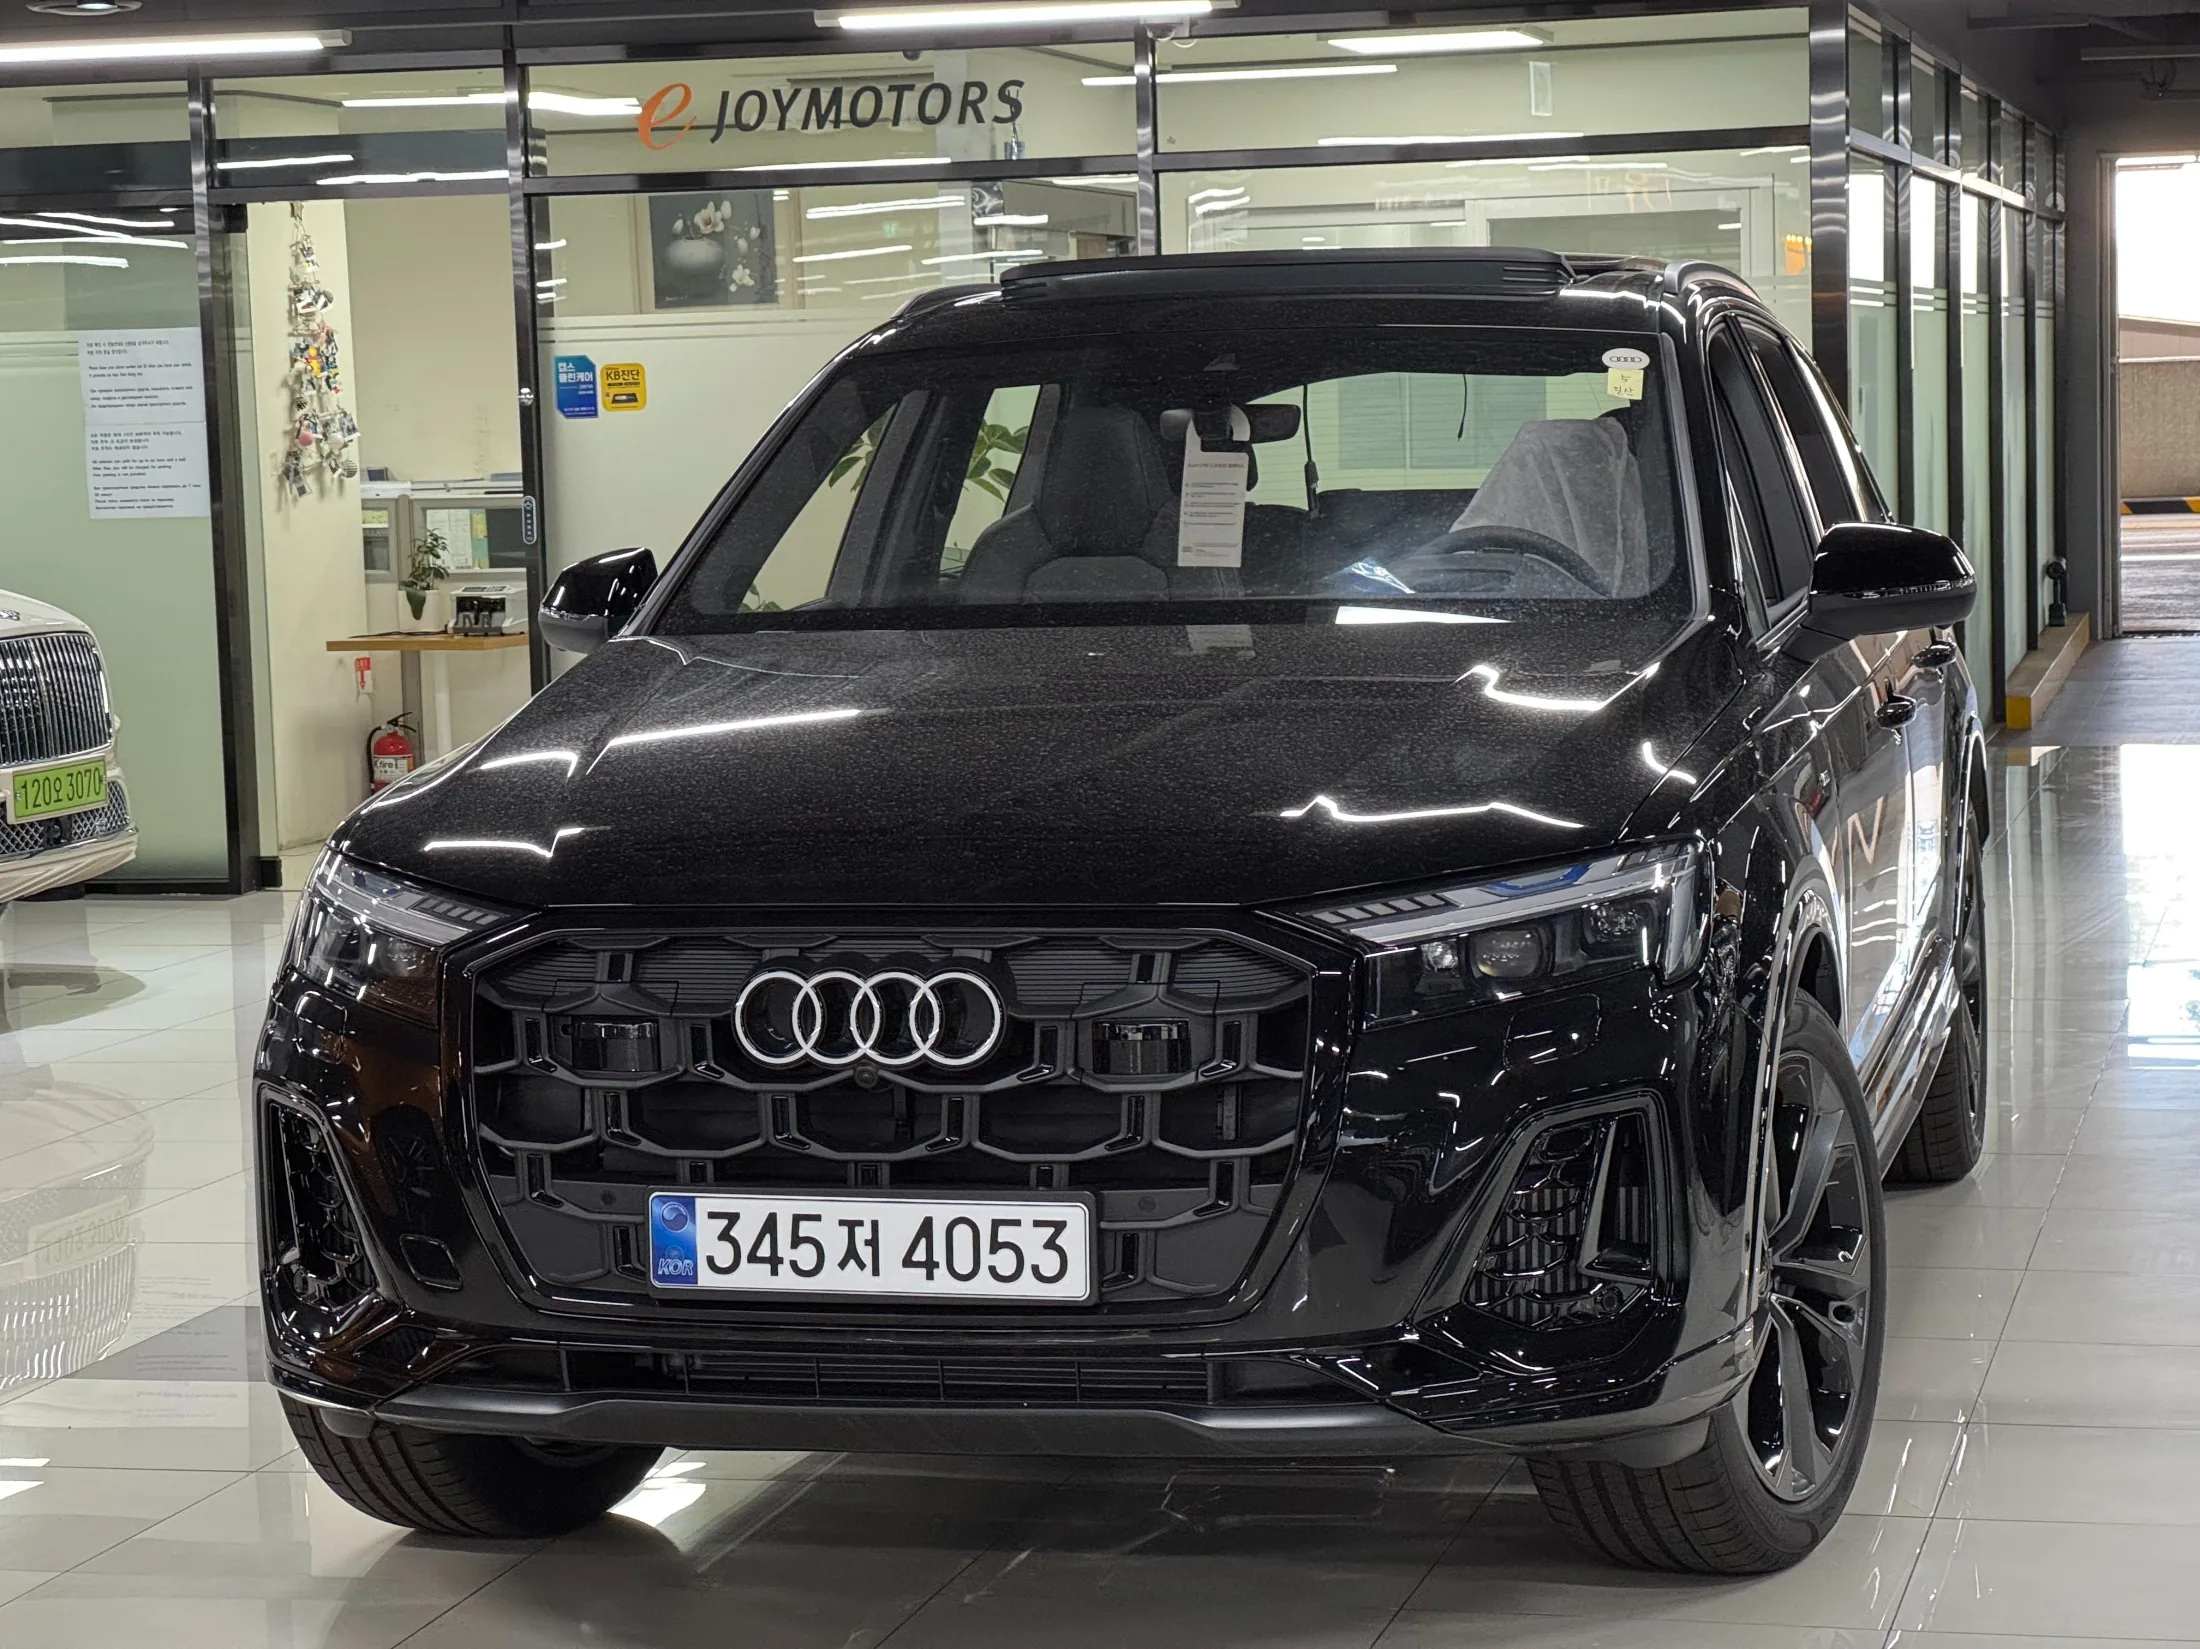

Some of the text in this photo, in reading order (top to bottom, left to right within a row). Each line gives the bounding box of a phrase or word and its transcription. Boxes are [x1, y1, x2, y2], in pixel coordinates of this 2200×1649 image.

[709, 79, 1025, 144] JOYMOTORS
[606, 369, 640, 380] KB진단
[379, 760, 394, 769] fire
[21, 767, 102, 810] 120오 3070
[705, 1211, 1069, 1284] 345저 4053
[657, 1257, 694, 1276] KOR
